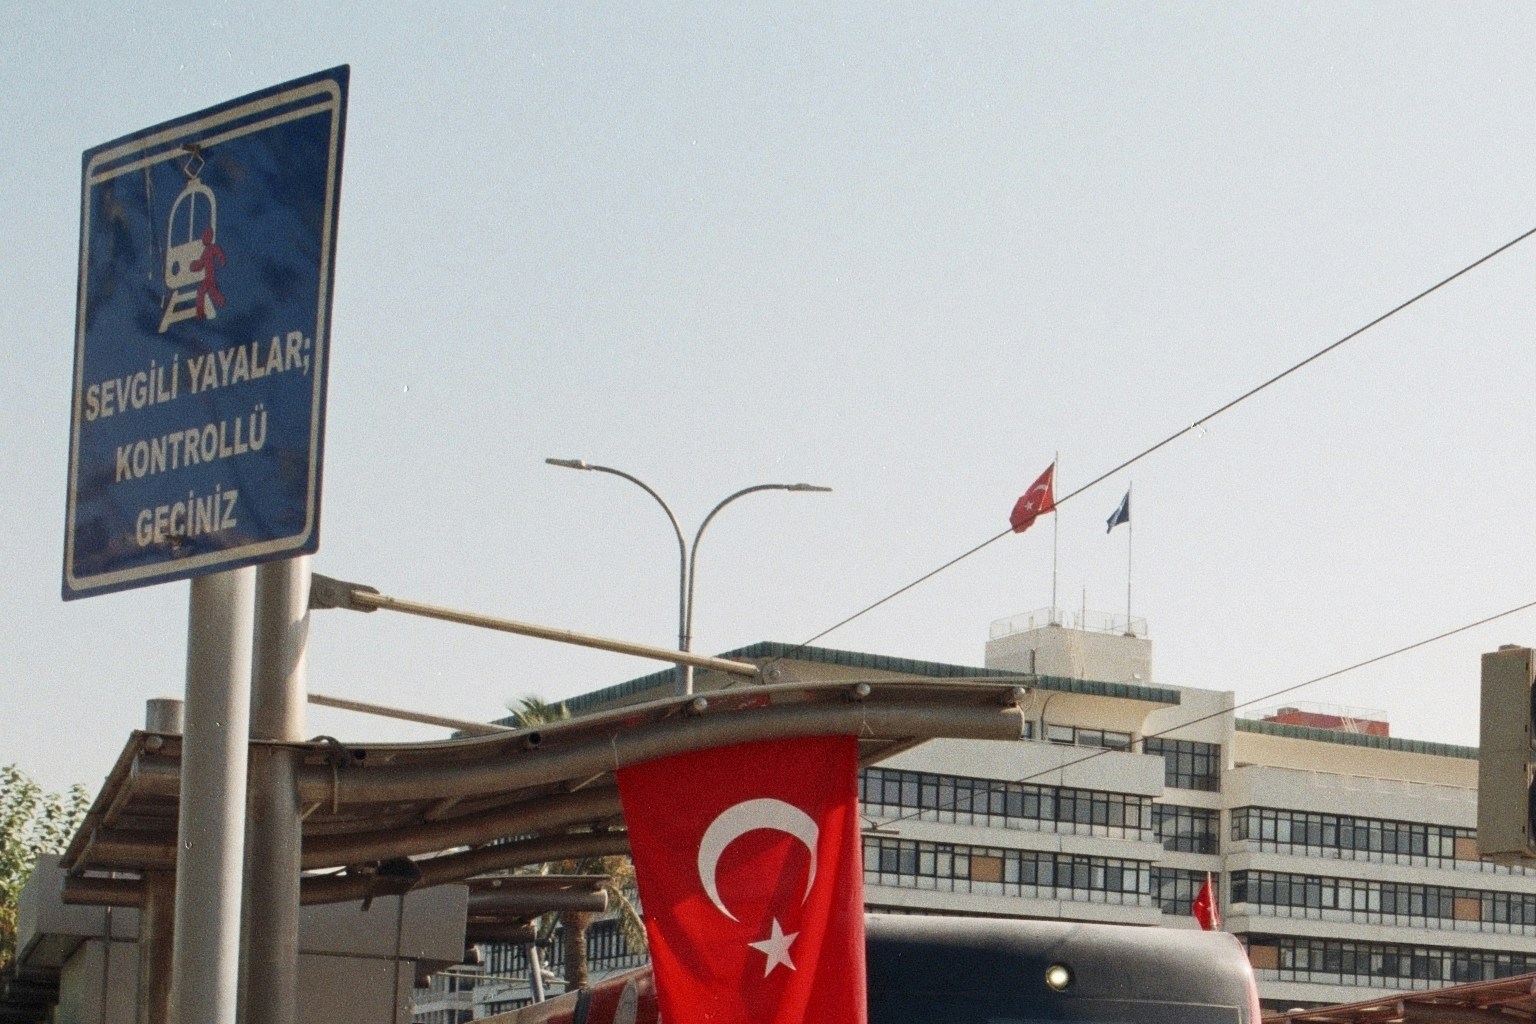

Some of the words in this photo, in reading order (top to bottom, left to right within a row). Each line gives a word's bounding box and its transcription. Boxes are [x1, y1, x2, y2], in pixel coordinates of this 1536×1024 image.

[85, 354, 179, 421] SEVGİLİ
[187, 331, 311, 394] YAYALAR;
[115, 403, 267, 482] KONTROLLÜ
[135, 483, 239, 547] GEÇİNİZ
